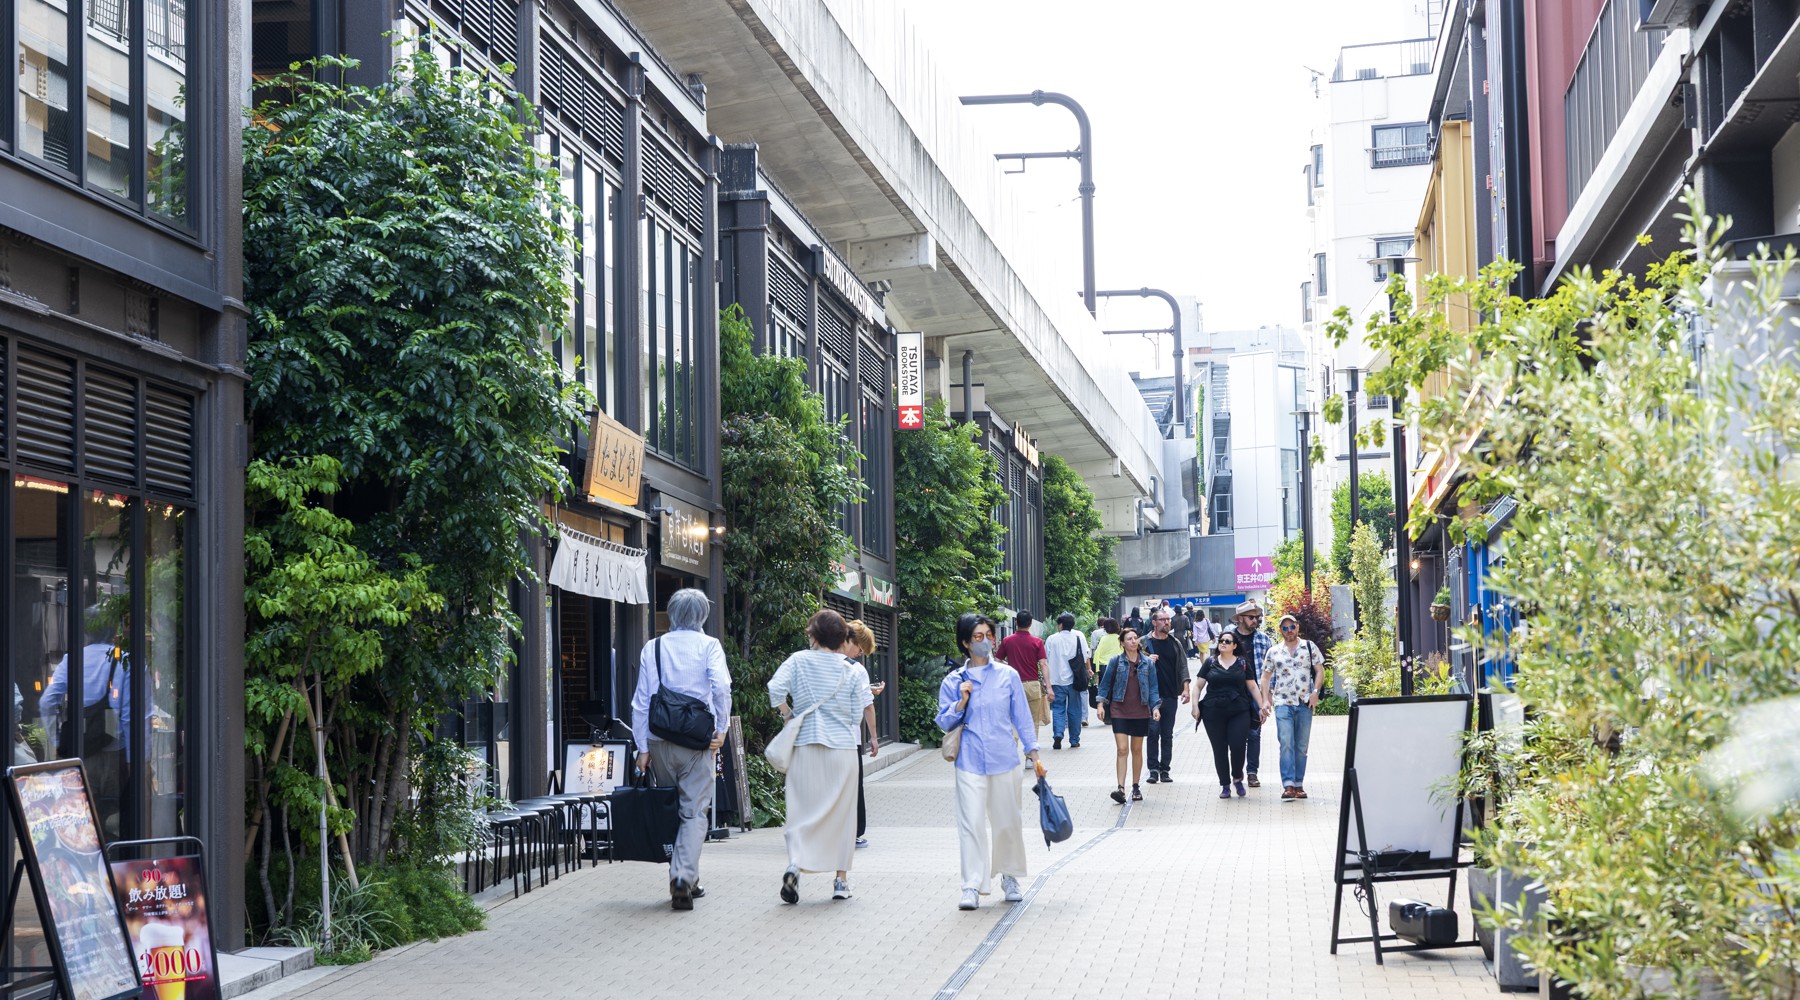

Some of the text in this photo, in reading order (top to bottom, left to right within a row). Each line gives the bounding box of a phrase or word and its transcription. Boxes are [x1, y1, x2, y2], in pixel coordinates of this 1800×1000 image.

[909, 346, 918, 395] TSUTAYA
[901, 407, 920, 426] 本
[142, 868, 161, 883] 90
[129, 883, 187, 903] 飲み放題!
[140, 948, 201, 979] 2000
